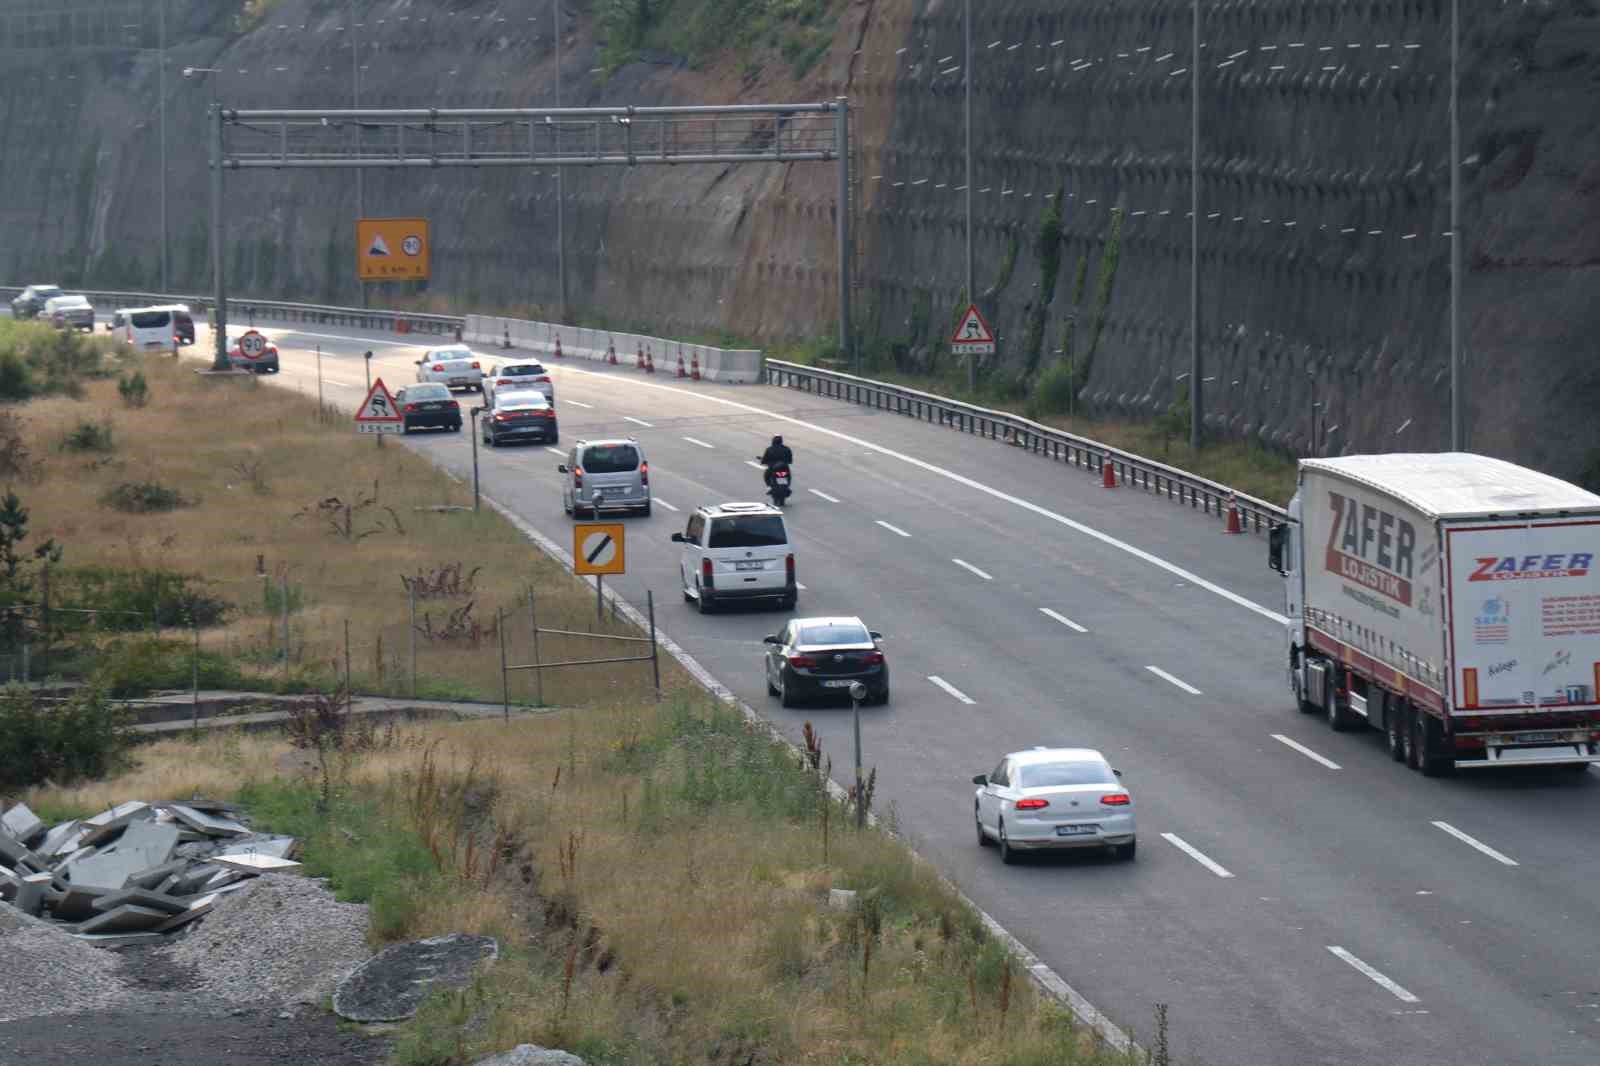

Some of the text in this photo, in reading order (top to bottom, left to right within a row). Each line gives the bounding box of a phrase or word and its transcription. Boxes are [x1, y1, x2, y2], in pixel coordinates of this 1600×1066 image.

[245, 338, 262, 351] 90
[1326, 490, 1416, 580] ZAFER
[1468, 553, 1593, 581] ZAFER
